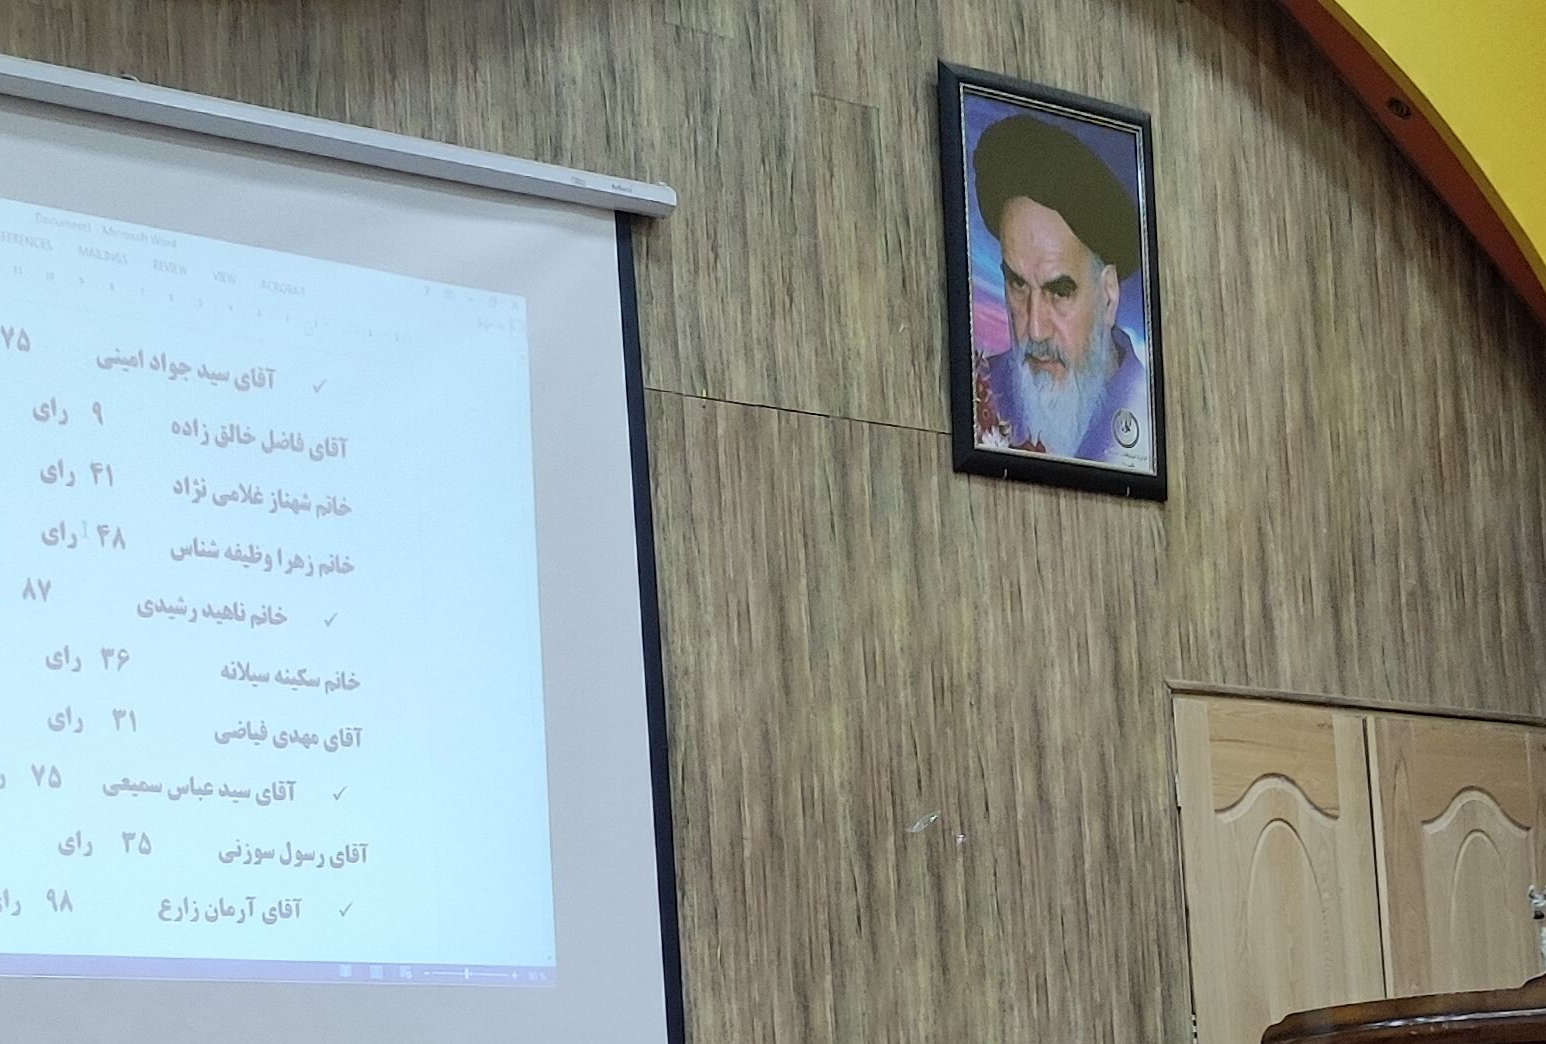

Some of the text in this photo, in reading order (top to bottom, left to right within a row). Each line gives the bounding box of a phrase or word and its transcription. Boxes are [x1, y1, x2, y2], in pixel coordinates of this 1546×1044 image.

[153, 258, 189, 277] REVIEW
[0, 324, 31, 353] ۷۵
[95, 347, 144, 373] امینی
[149, 352, 192, 382] جواد
[196, 363, 230, 387] سید
[233, 366, 276, 392] آقای
[32, 396, 349, 462] آقای فاضل خالق زاده ۹ رای
[39, 458, 353, 519] خانم شهناز غلامی نژاد ۴۱ رای
[40, 520, 356, 578] خانم زهرا وظیفه شناس ۴۸ رای
[21, 577, 52, 603] ۸۷
[136, 595, 198, 624] رشیدی
[201, 601, 247, 625] ناهید
[249, 604, 288, 629] خانم
[44, 644, 82, 673] رای
[100, 646, 131, 672] ۳۶
[273, 667, 321, 692] سکینه
[324, 670, 361, 695] خانم
[47, 705, 363, 754] آقای مهدی فیاضی ۳۱ رای
[30, 763, 63, 789] ۷۵
[101, 776, 163, 798] سمیعی
[166, 775, 214, 802] عباس
[217, 782, 252, 804] سید
[255, 779, 297, 807] آقای
[57, 829, 369, 870] آقای رسول سوزنی ۳۵ رای
[45, 888, 74, 913] ۹۸
[157, 895, 200, 923] زارع
[204, 895, 257, 925] آرمان
[261, 897, 303, 926] آقای
